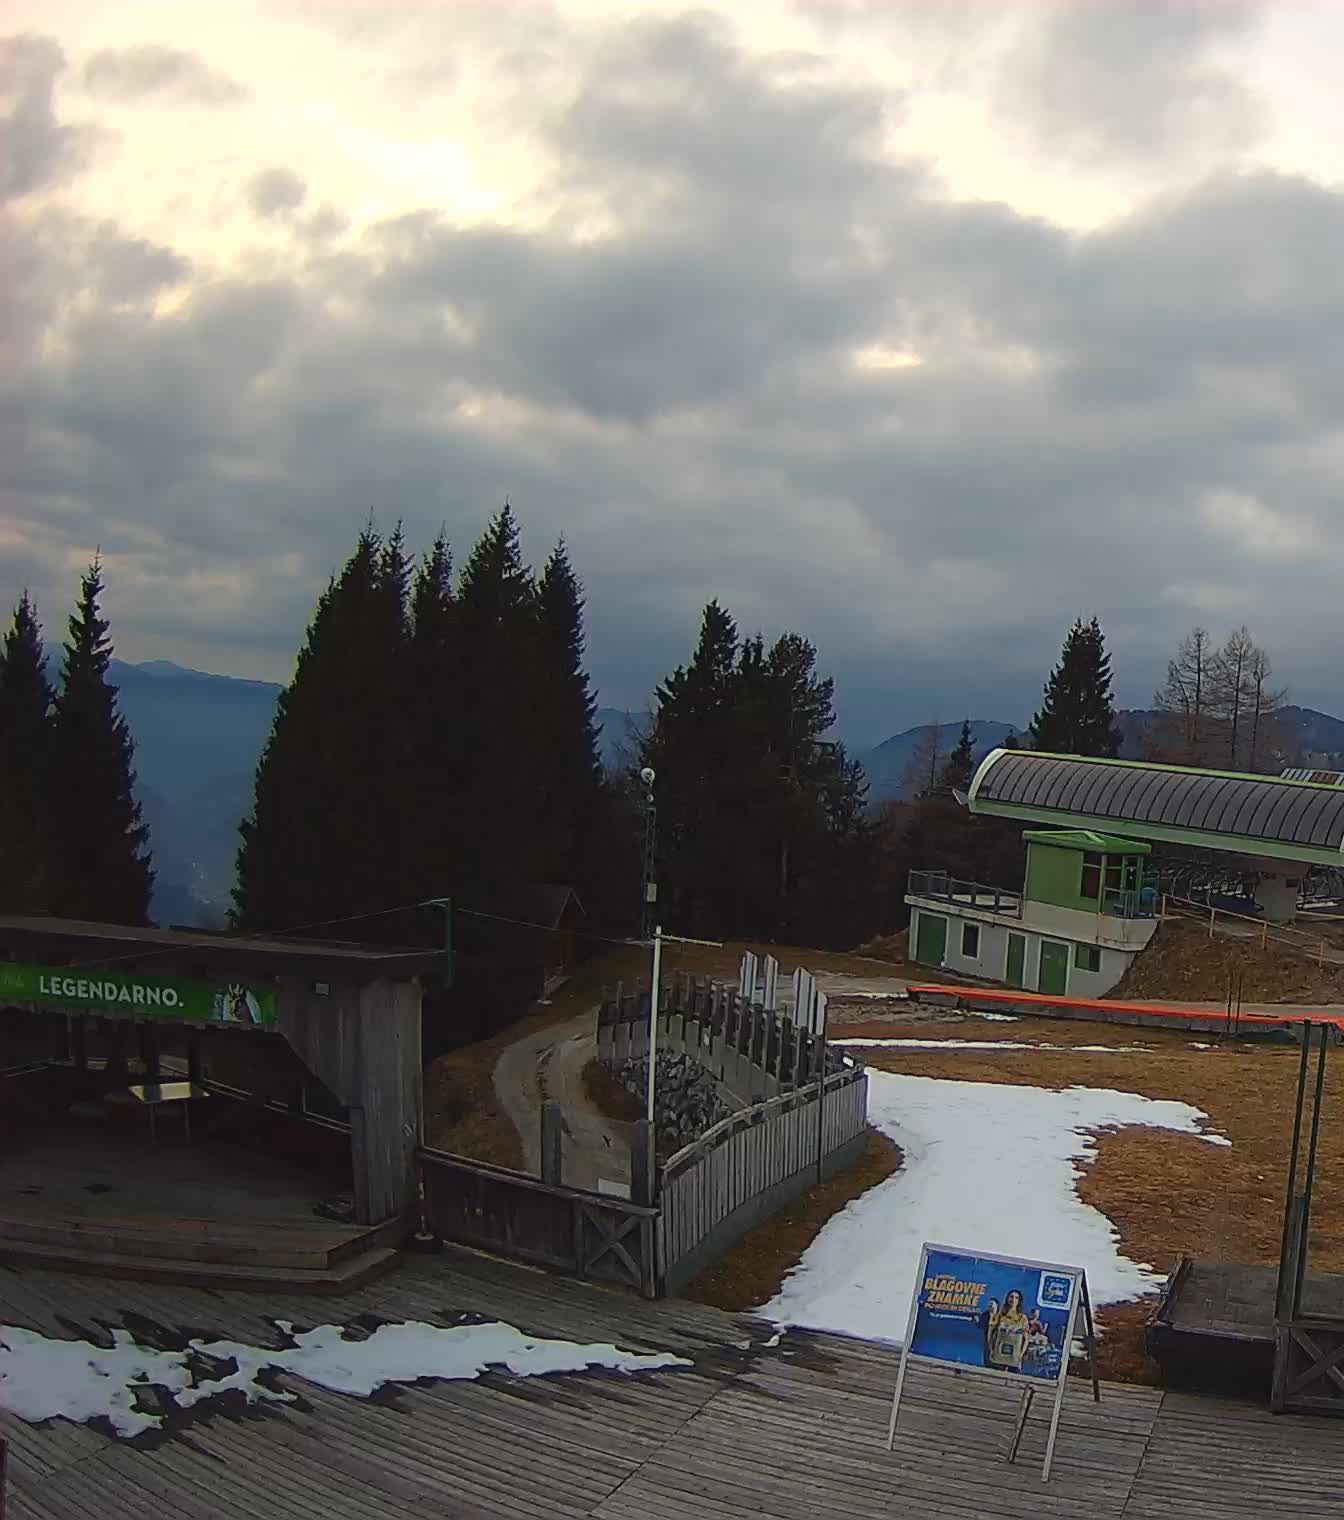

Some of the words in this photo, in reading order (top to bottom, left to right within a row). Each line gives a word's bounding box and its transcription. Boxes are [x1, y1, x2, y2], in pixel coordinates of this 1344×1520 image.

[39, 975, 185, 1008] LEGENDARNO.
[925, 1277, 987, 1295] BLAGOVNE
[927, 1291, 980, 1307] ZNAMKE
